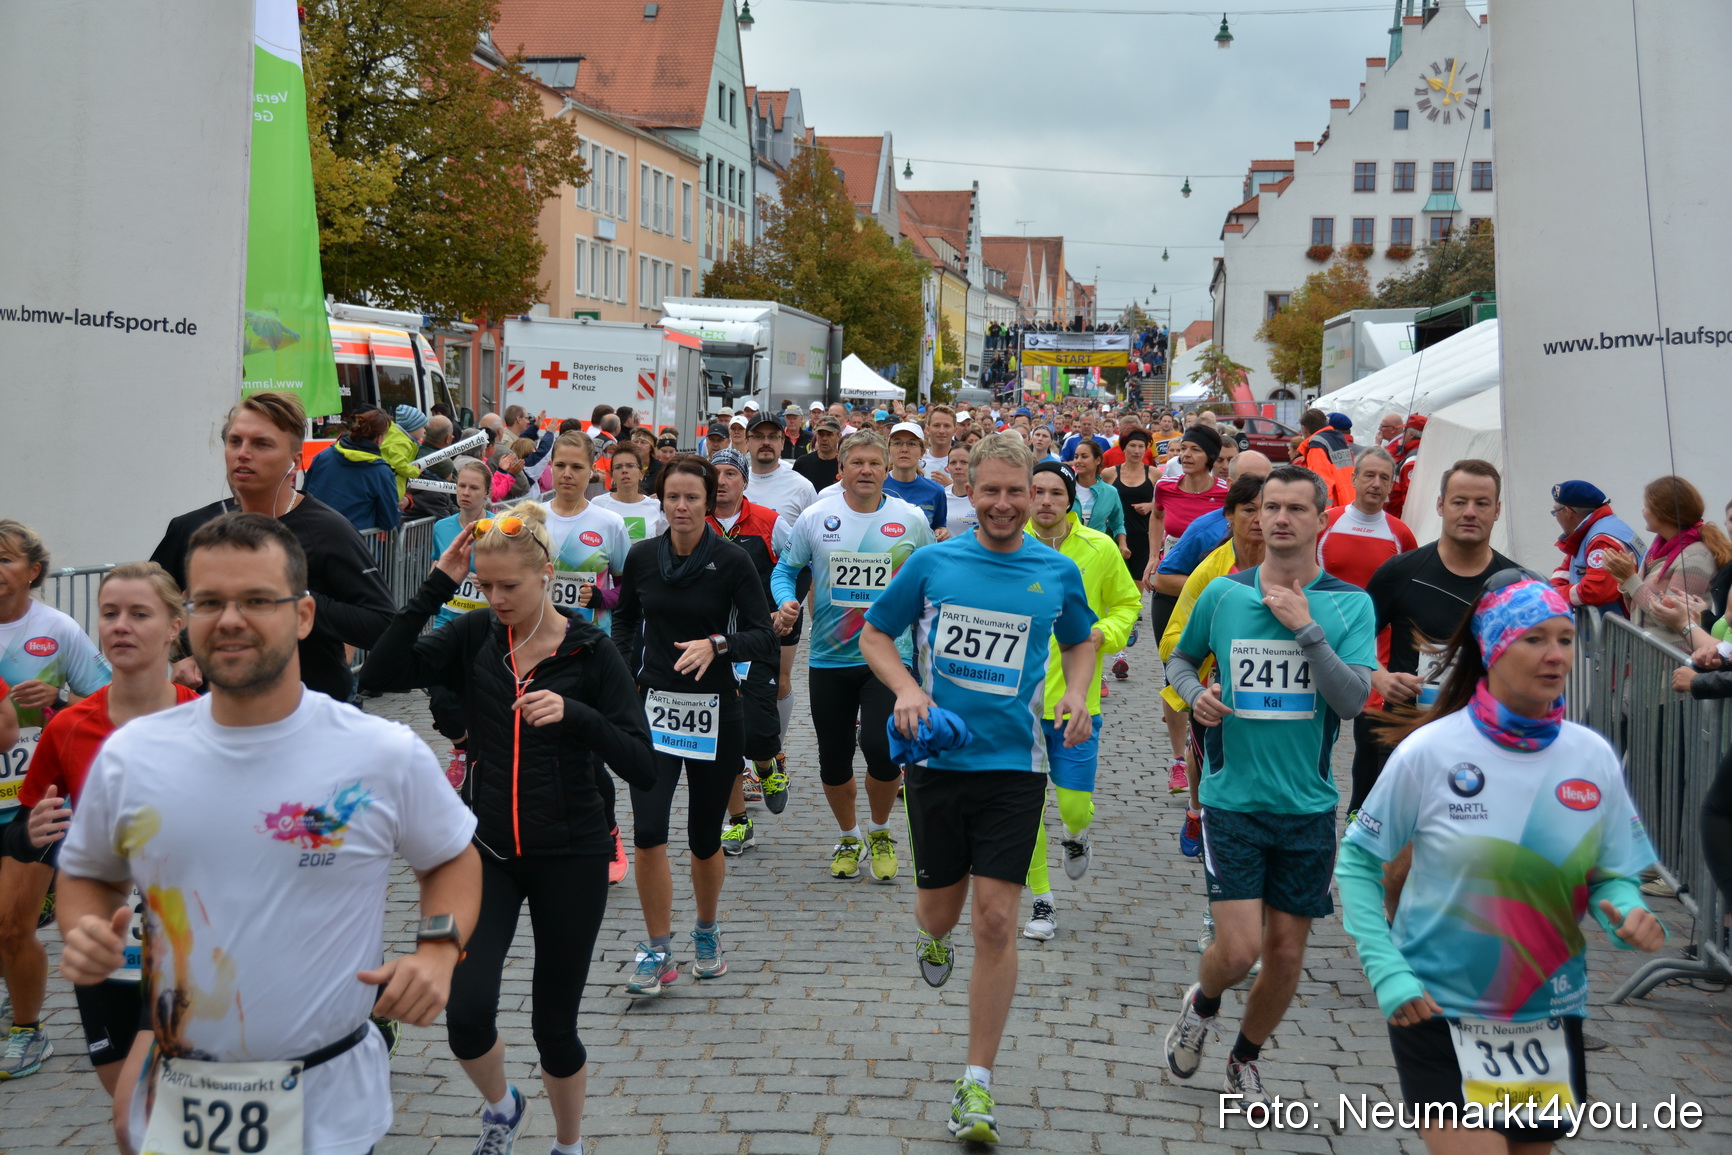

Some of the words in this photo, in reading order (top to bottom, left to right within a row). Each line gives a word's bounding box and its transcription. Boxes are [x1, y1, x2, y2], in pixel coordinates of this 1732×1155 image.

[1056, 354, 1093, 363] START
[573, 362, 624, 373] Bayerisches
[572, 373, 597, 382] Rotes
[572, 383, 596, 392] Kreuz
[844, 388, 878, 397] Laufsport
[425, 436, 486, 467] bmw-laufsport.de
[831, 556, 852, 564] PARTL
[836, 565, 887, 587] 2212
[850, 591, 870, 600] Felix
[453, 599, 476, 610] Kerstin
[942, 611, 971, 623] PARTL
[973, 616, 1014, 630] Neumarkt
[29, 641, 56, 652] Hervis
[944, 625, 1020, 663] 2577
[1232, 647, 1260, 655] PARTL
[1262, 648, 1304, 656] Neumarkt
[948, 662, 1005, 683] Sebastian
[1239, 658, 1311, 689] 2414
[649, 694, 671, 704] PARTL
[672, 699, 706, 707] Neumarkt
[1263, 696, 1282, 708] Kai
[652, 706, 712, 734] 2549
[661, 735, 698, 749] Martina
[1561, 785, 1597, 803] Hervis
[1449, 803, 1488, 813] PARTL
[298, 853, 336, 868] 2012
[1550, 974, 1572, 994] 16.
[1492, 1023, 1544, 1035] Neumarkt
[1475, 1037, 1550, 1077] 310
[161, 1069, 198, 1089] PARTL
[200, 1078, 274, 1092] Neumarkt
[1495, 1087, 1543, 1105] Claudia
[182, 1096, 269, 1154] 528
